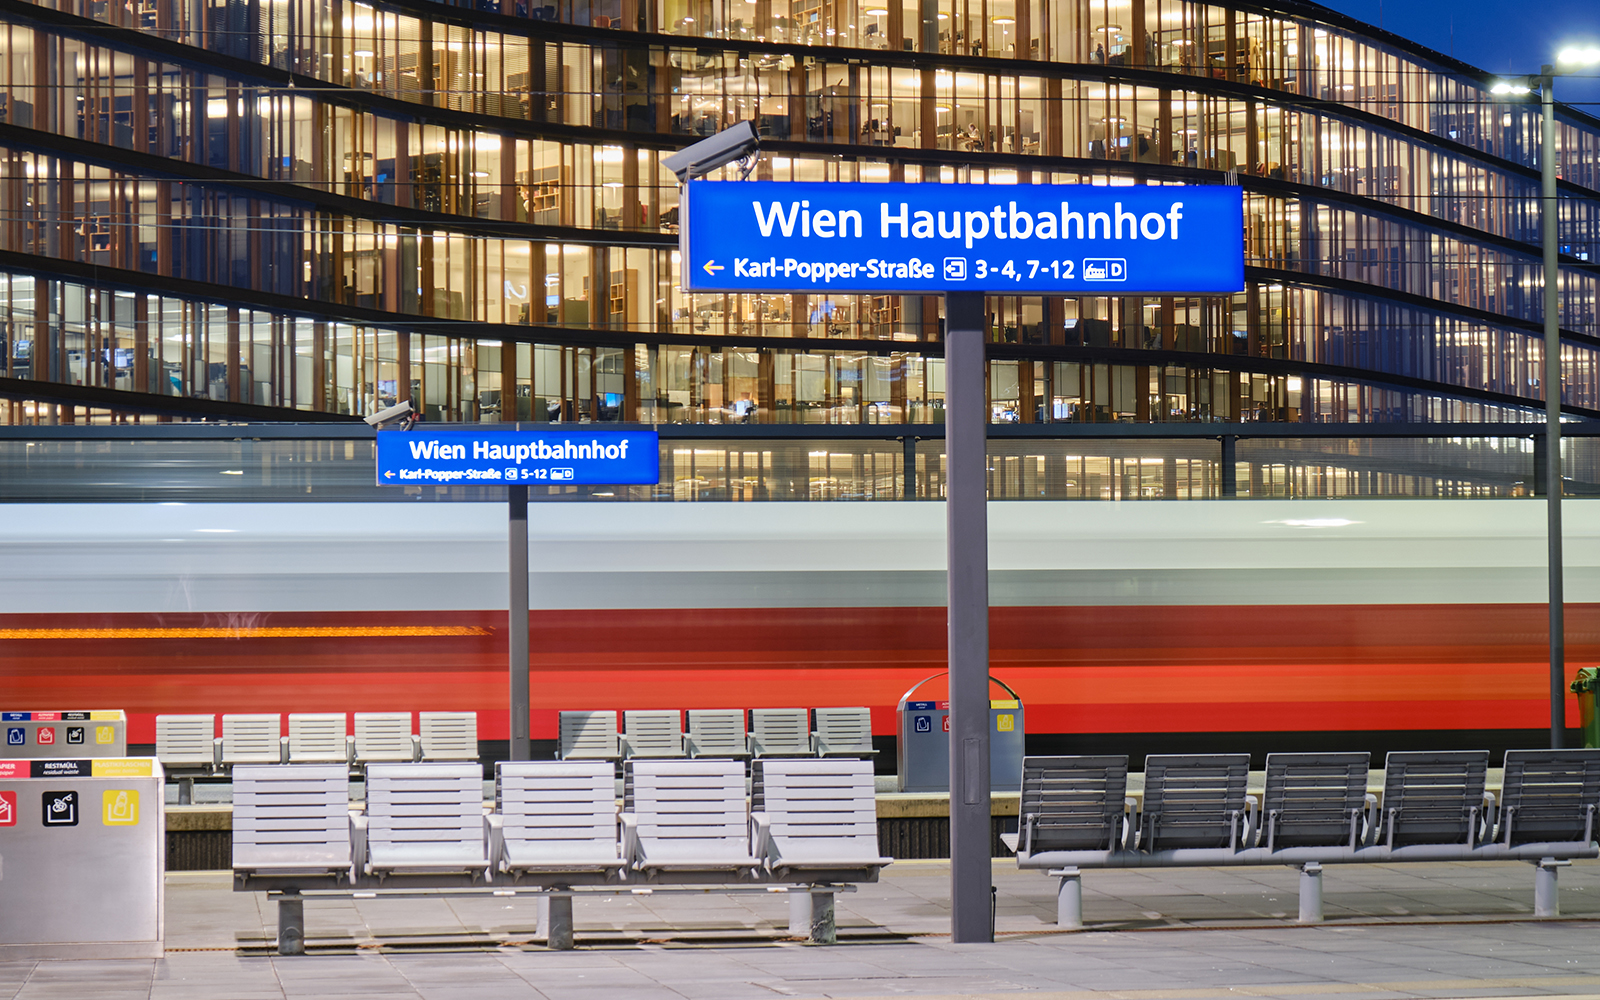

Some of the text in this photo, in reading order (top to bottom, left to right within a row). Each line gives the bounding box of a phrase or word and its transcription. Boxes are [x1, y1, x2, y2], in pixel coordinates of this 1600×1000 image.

[752, 200, 1184, 249] Wien Hauptbahnhof
[734, 256, 935, 283] Karl-Popper-Straße
[1026, 259, 1075, 280] 7-12
[1110, 262, 1123, 277] D
[408, 439, 629, 465] Wien Hauptbahnhof
[399, 467, 502, 481] Karl-Popper-Straße
[520, 468, 548, 480] 5-12
[44, 761, 78, 769] RESTMÜLL
